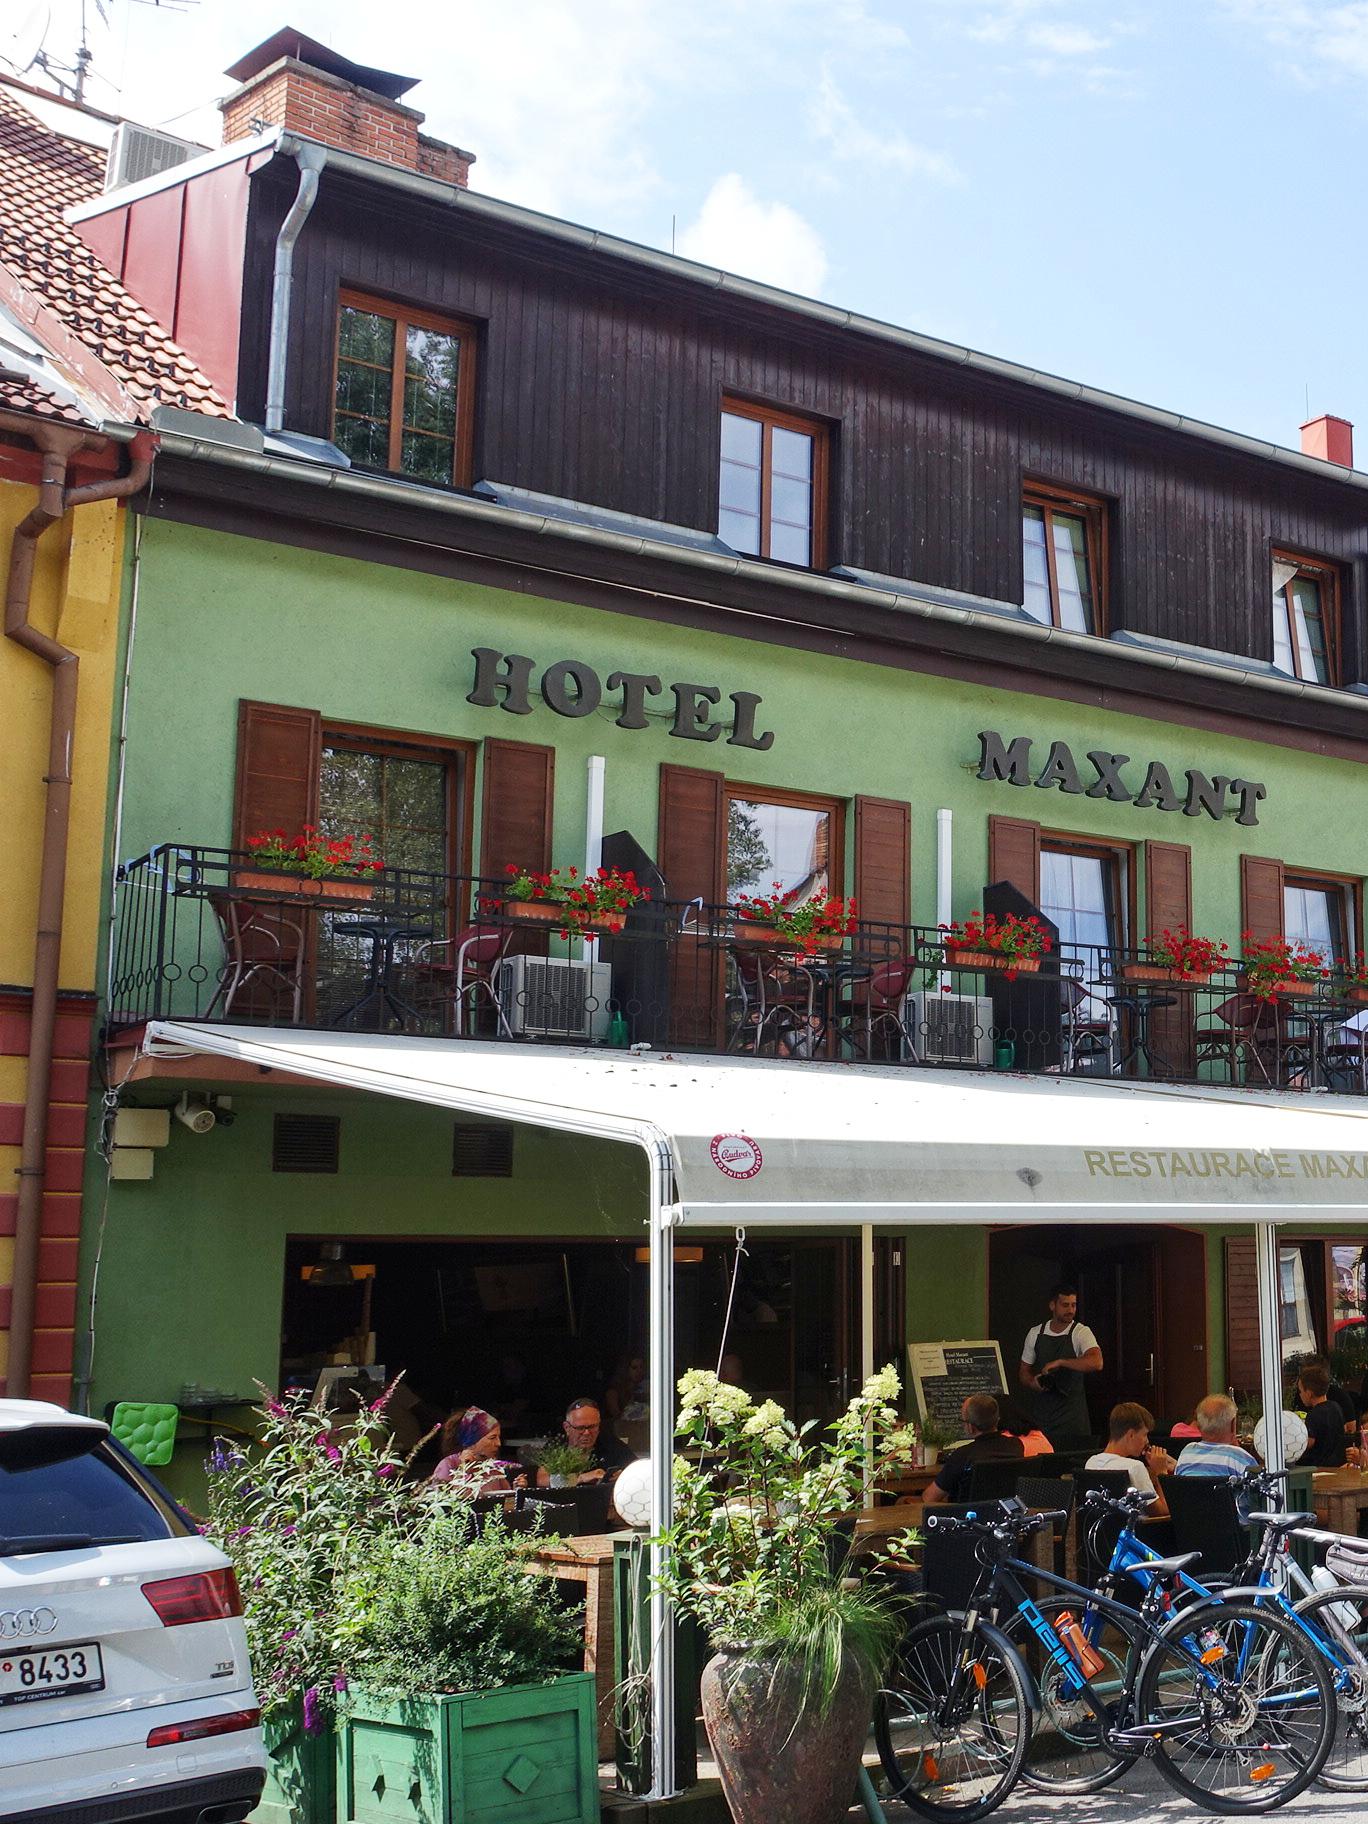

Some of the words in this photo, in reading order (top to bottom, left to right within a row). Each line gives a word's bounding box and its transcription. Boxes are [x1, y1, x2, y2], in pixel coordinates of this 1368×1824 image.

[466, 647, 775, 750] HOTEL
[976, 730, 1267, 826] MAXANT
[1084, 1150, 1296, 1178] RESTAURACE
[20, 1652, 87, 1686] 8433
